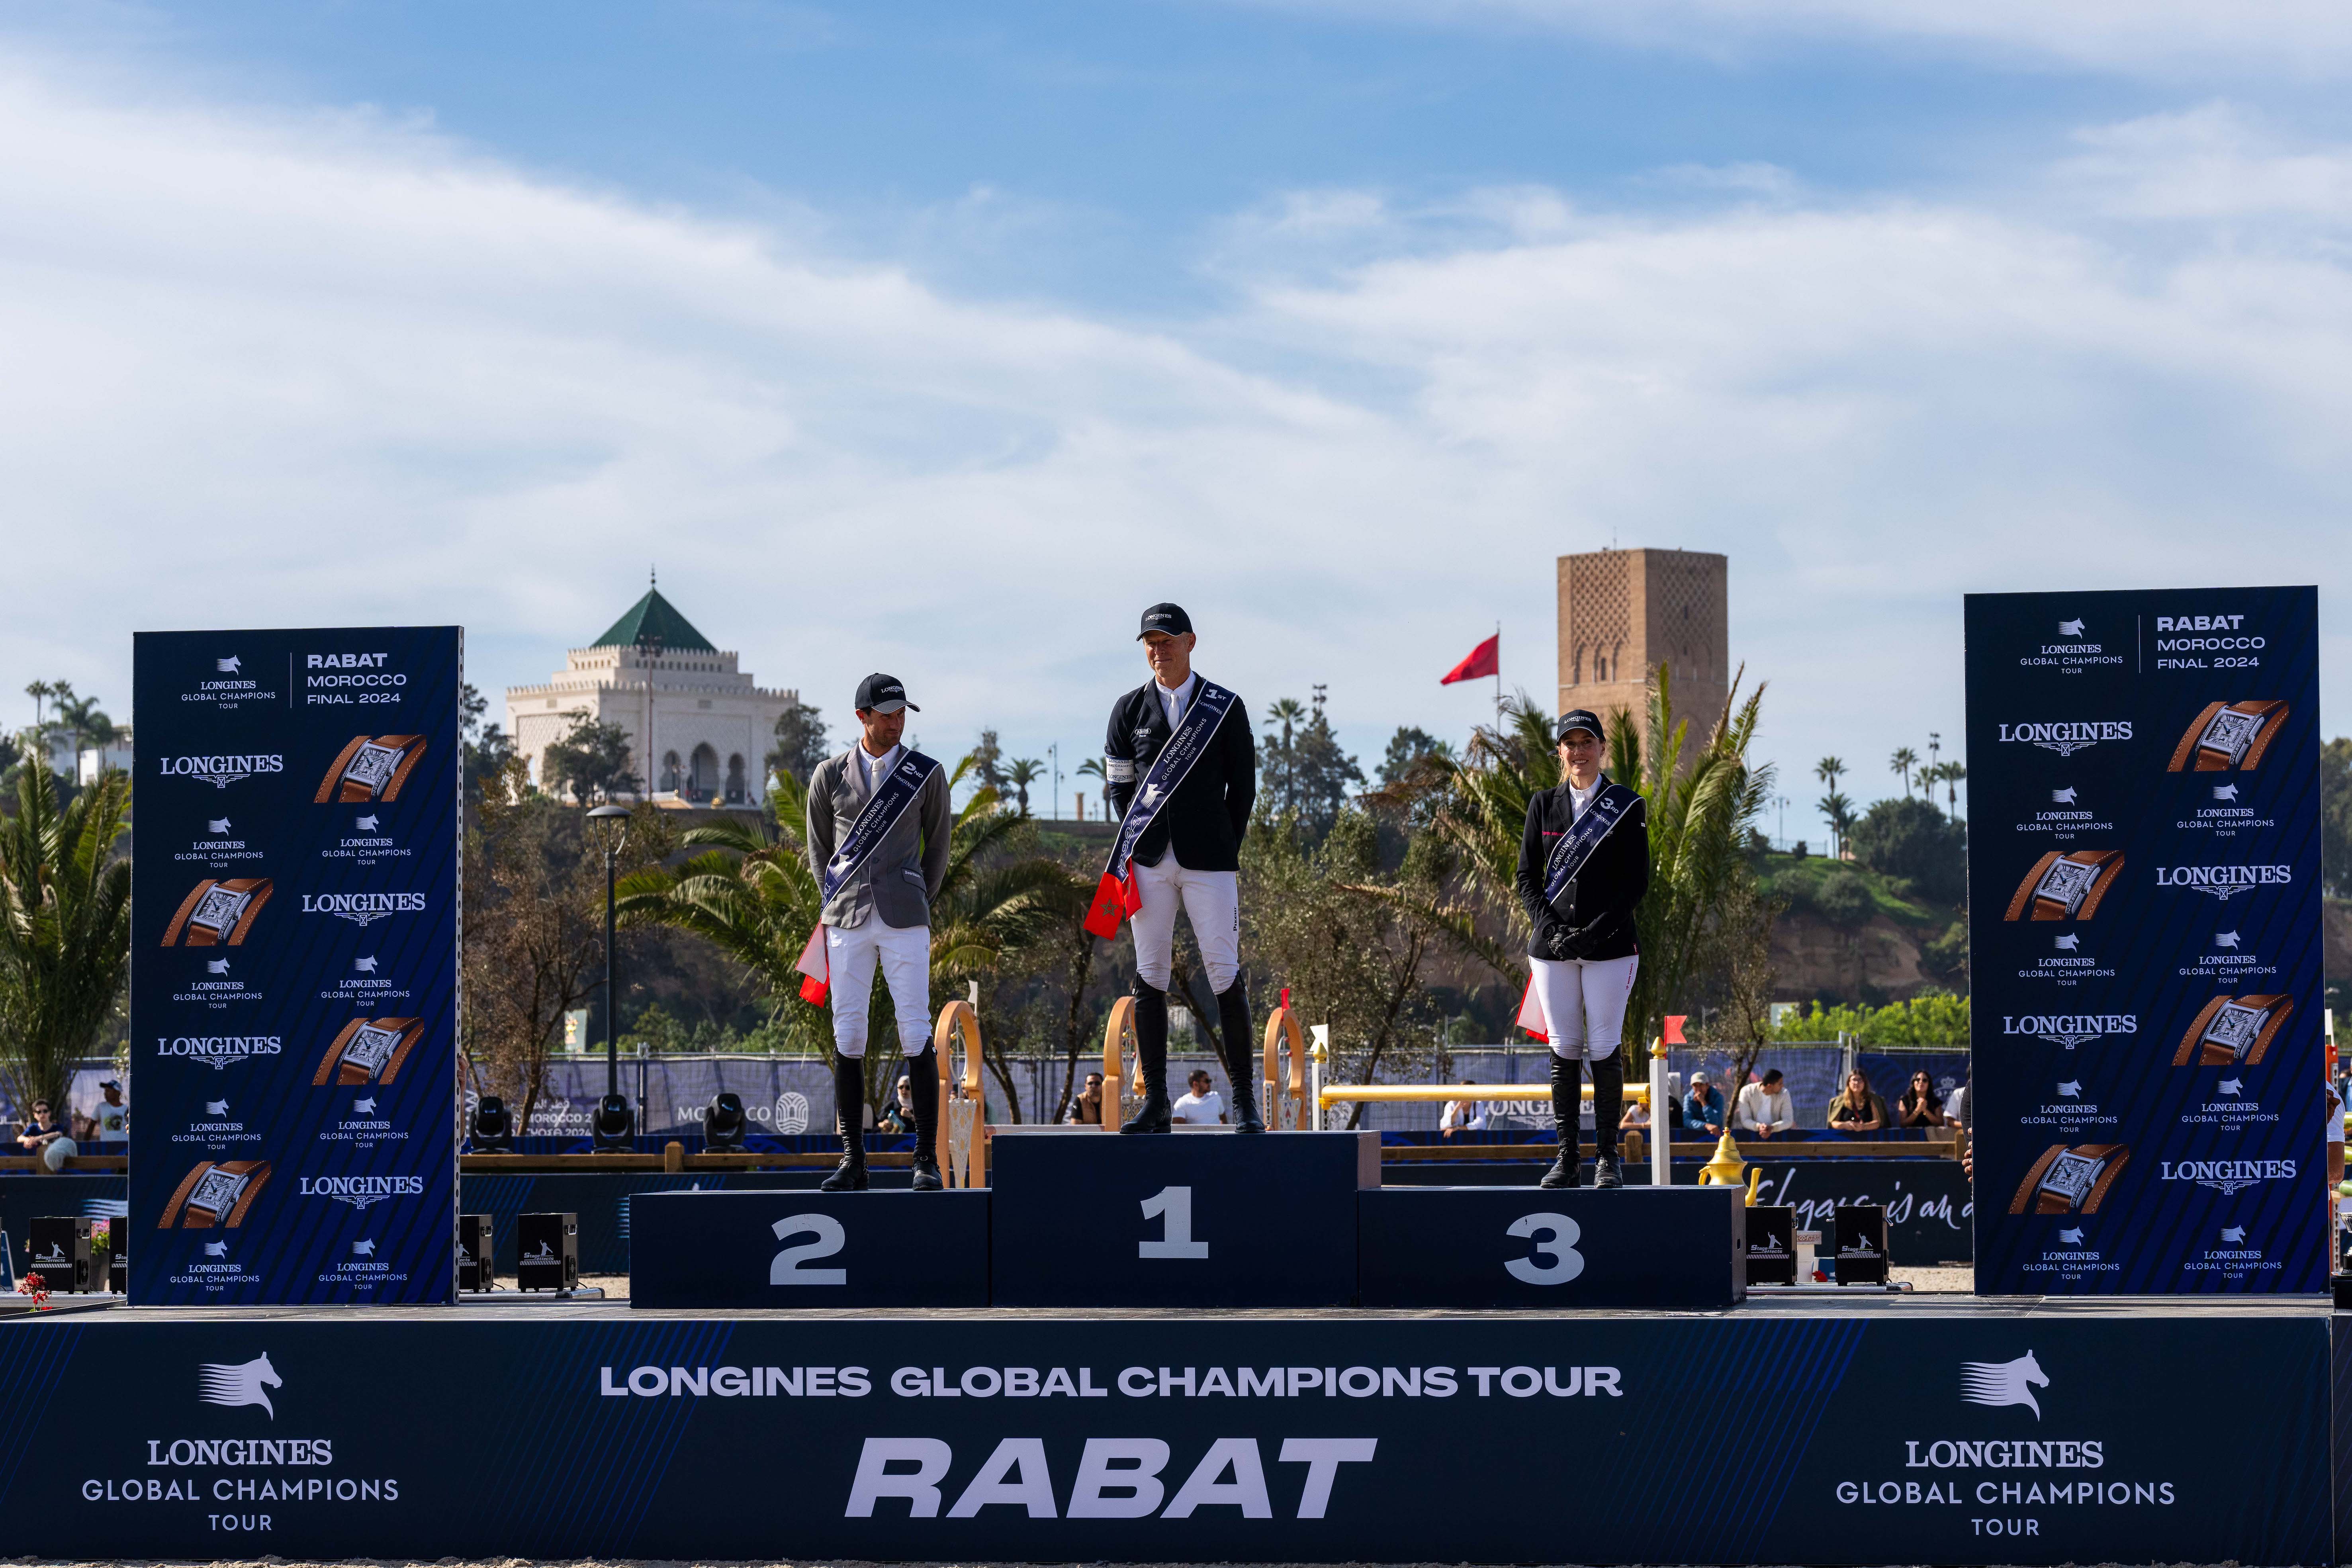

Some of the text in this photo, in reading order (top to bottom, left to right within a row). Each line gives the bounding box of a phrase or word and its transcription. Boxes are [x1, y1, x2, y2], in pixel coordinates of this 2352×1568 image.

[2158, 615, 2244, 631] RABAT
[2041, 645, 2101, 654] LONGINES
[2158, 637, 2265, 651] MOROCCO
[308, 653, 387, 668] RABAT
[2158, 657, 2259, 669] FINAL 2024
[201, 681, 256, 689] LONGINES
[308, 674, 406, 687] MOROCCO
[308, 693, 400, 704] FINAL 2024
[1206, 689, 1227, 700] 1ST
[1199, 700, 1223, 715] LONGINES
[1564, 716, 1592, 724] LONGINES
[1999, 722, 2132, 741] LONGINES
[1162, 718, 1207, 780] GLOBAL CHAMPIONS
[1163, 726, 1192, 764] LONGINES
[1185, 747, 1197, 760] TOUR
[161, 755, 283, 774] LONGINES
[902, 762, 923, 778] 2ND
[894, 773, 916, 791] LONGINES
[1600, 797, 1619, 814] 3RD
[2197, 808, 2254, 817] LONGINES
[853, 792, 899, 852] GLOBAL CHAMPIONS
[855, 799, 884, 836] LONGINES
[1589, 808, 1611, 826] LONGINES
[876, 820, 887, 833] TOUR
[1118, 814, 1142, 872] 2024
[1551, 828, 1593, 887] GLOBAL CHAMPIONS
[1552, 834, 1577, 871] LONGINES
[1568, 856, 1579, 869] TOUR
[2157, 865, 2291, 885] LONGINES
[303, 893, 425, 912] LONGINES
[2199, 955, 2256, 964] LONGINES
[2004, 1015, 2137, 1034] LONGINES
[158, 1037, 281, 1055] LONGINES
[678, 1107, 771, 1122] MOCO
[2162, 1160, 2296, 1179] LONGINES
[300, 1176, 423, 1194] LONGINES
[1920, 1194, 1961, 1229] an
[1139, 1186, 1208, 1259] 1
[770, 1214, 846, 1285] 2
[1504, 1212, 1585, 1285] 3
[601, 1366, 1623, 1397] LONGINES GLOBAL CHAMPIONS TOUR
[148, 1439, 332, 1465] LONGINES
[1906, 1441, 2103, 1468] LONGINES
[845, 1438, 1378, 1518] RABAT
[82, 1479, 398, 1500] GLOBAL CHAMPIONS
[1837, 1482, 2174, 1504] GLOBAL CHAMPIONS
[209, 1515, 271, 1530] TOUR
[1972, 1519, 2039, 1535] TOUR
